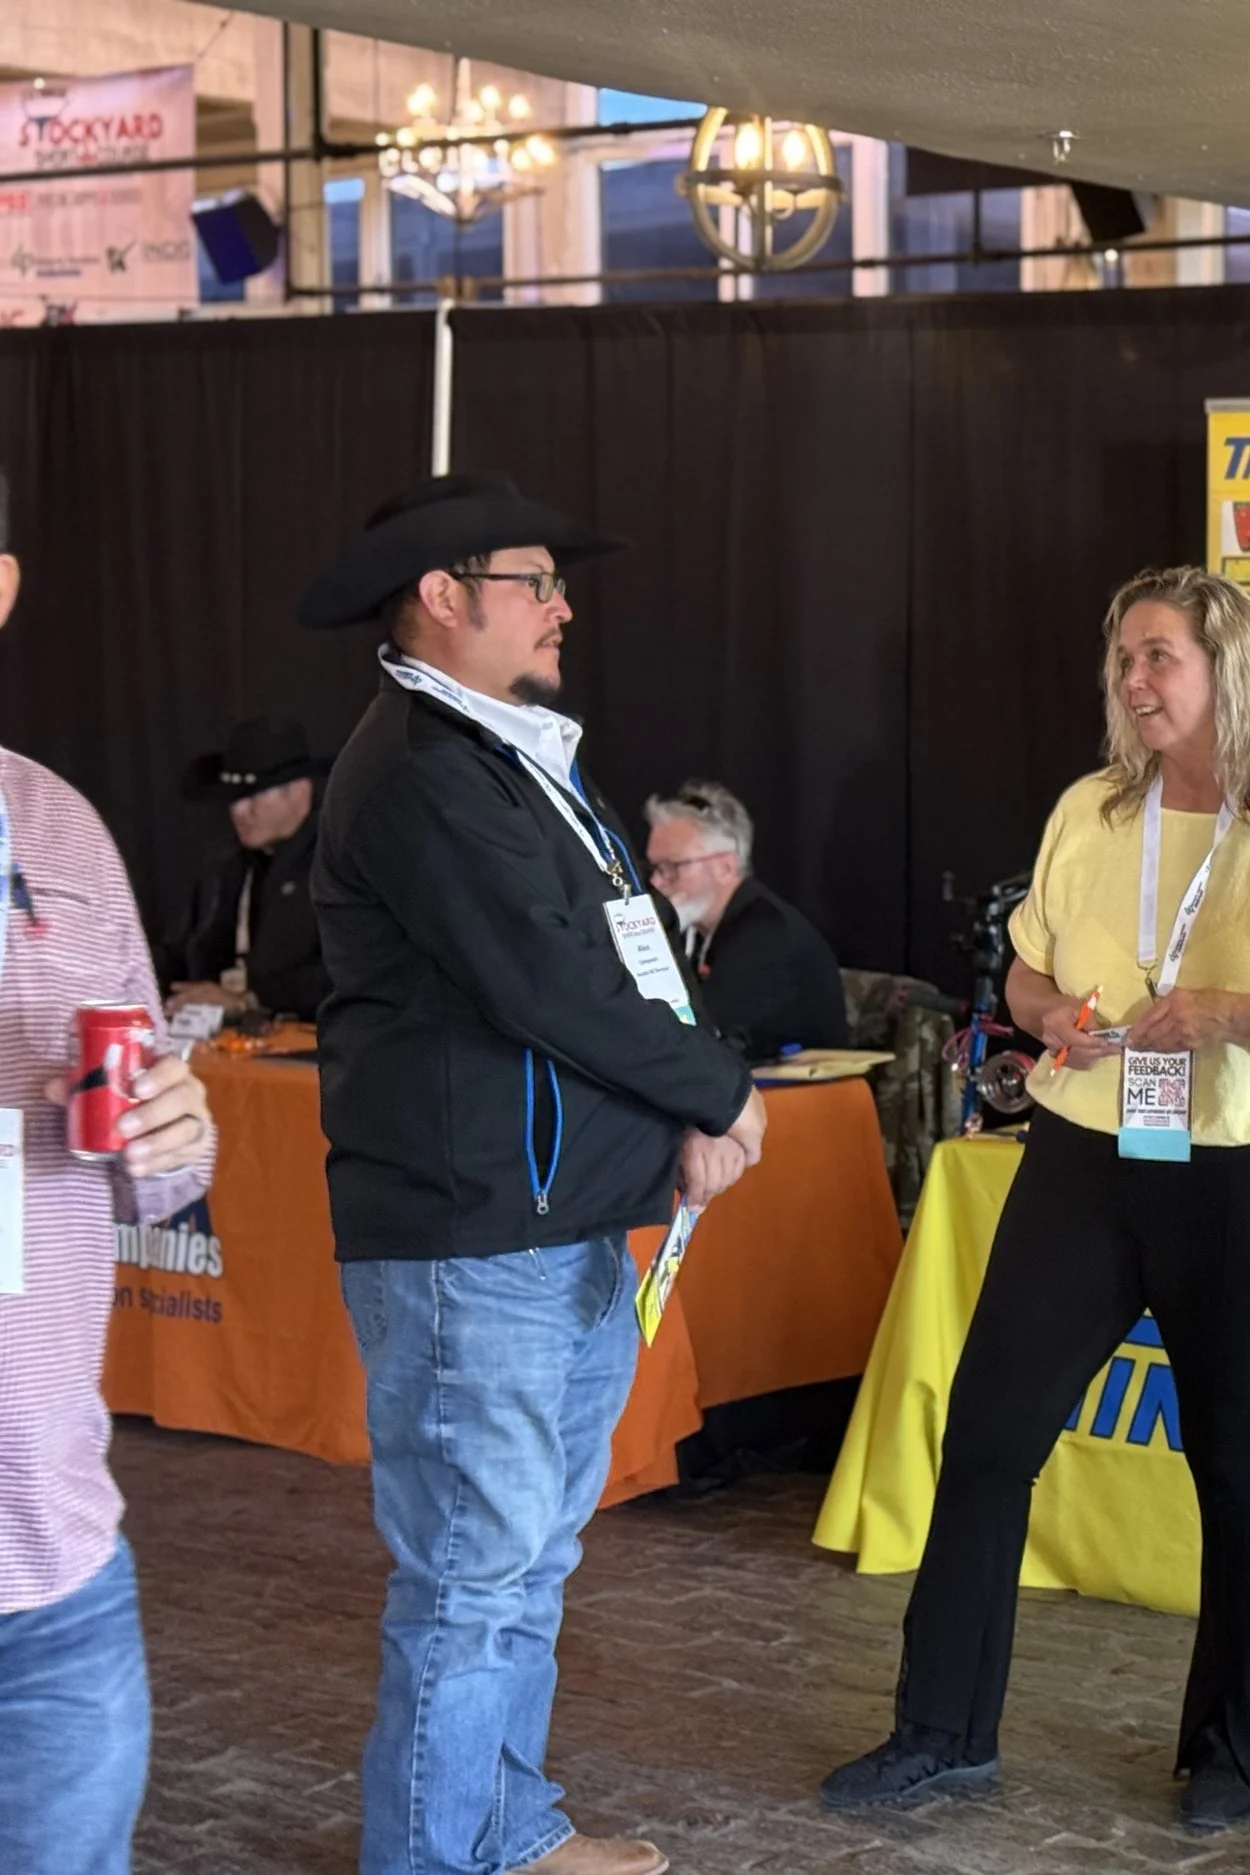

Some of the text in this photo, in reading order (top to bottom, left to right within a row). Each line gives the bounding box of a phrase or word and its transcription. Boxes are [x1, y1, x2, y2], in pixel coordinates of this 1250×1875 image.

[19, 113, 163, 148] STOCKYARD
[1128, 1057, 1187, 1067] GIVE US YOUR
[1128, 1077, 1156, 1087] SCAN
[1127, 1087, 1156, 1106] ME
